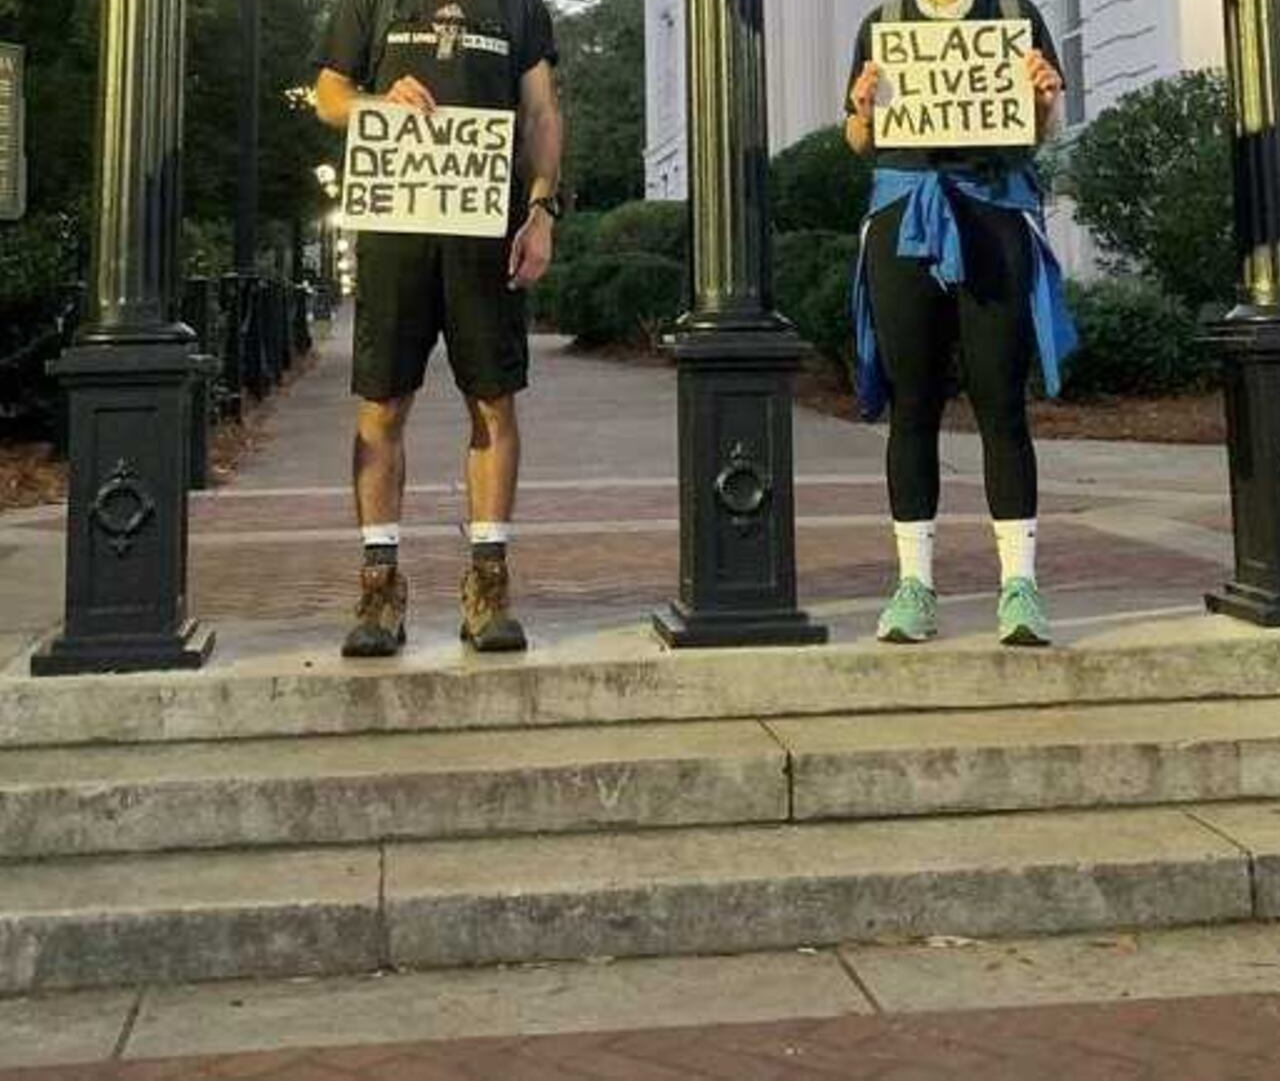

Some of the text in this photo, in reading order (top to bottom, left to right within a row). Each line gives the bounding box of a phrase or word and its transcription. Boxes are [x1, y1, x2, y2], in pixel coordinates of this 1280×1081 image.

[879, 25, 1026, 64] BLACK
[898, 62, 1014, 96] LIVES
[358, 109, 509, 151] DAWGS
[881, 98, 1025, 138] MATTER
[349, 145, 509, 183] DEMAND
[345, 181, 504, 217] BETTER
